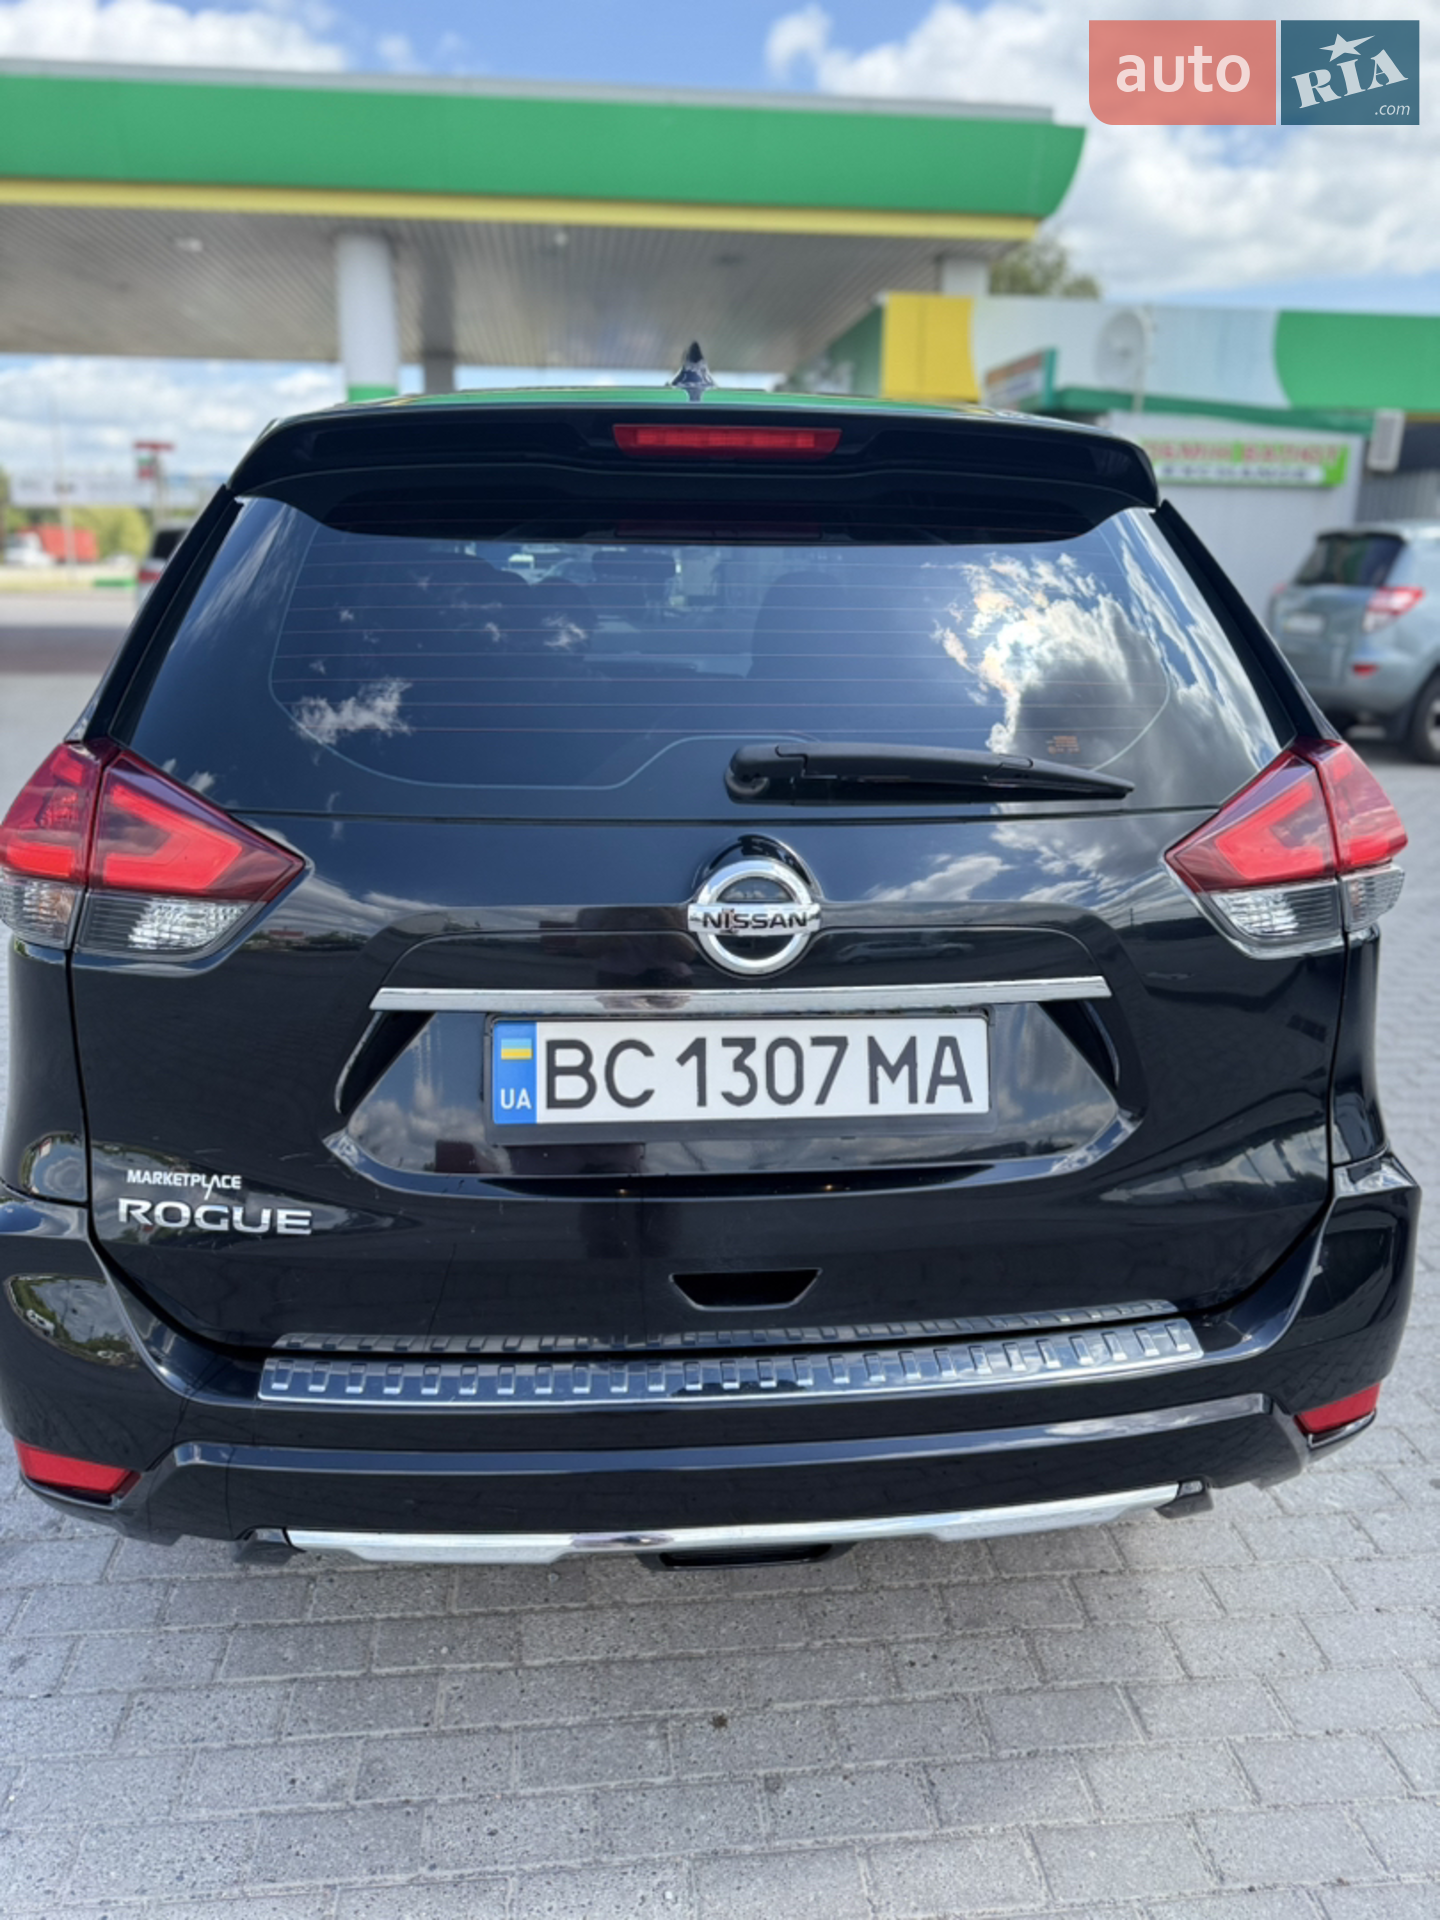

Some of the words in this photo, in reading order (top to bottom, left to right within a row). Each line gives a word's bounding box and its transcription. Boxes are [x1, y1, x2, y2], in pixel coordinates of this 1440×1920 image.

[702, 911, 807, 930] NISSAN
[545, 1038, 656, 1110] BC
[675, 1036, 849, 1108] 1307
[867, 1035, 974, 1105] MA
[500, 1088, 532, 1111] UA
[126, 1169, 242, 1200] MARKETPLACE
[118, 1197, 312, 1235] ROGUE
